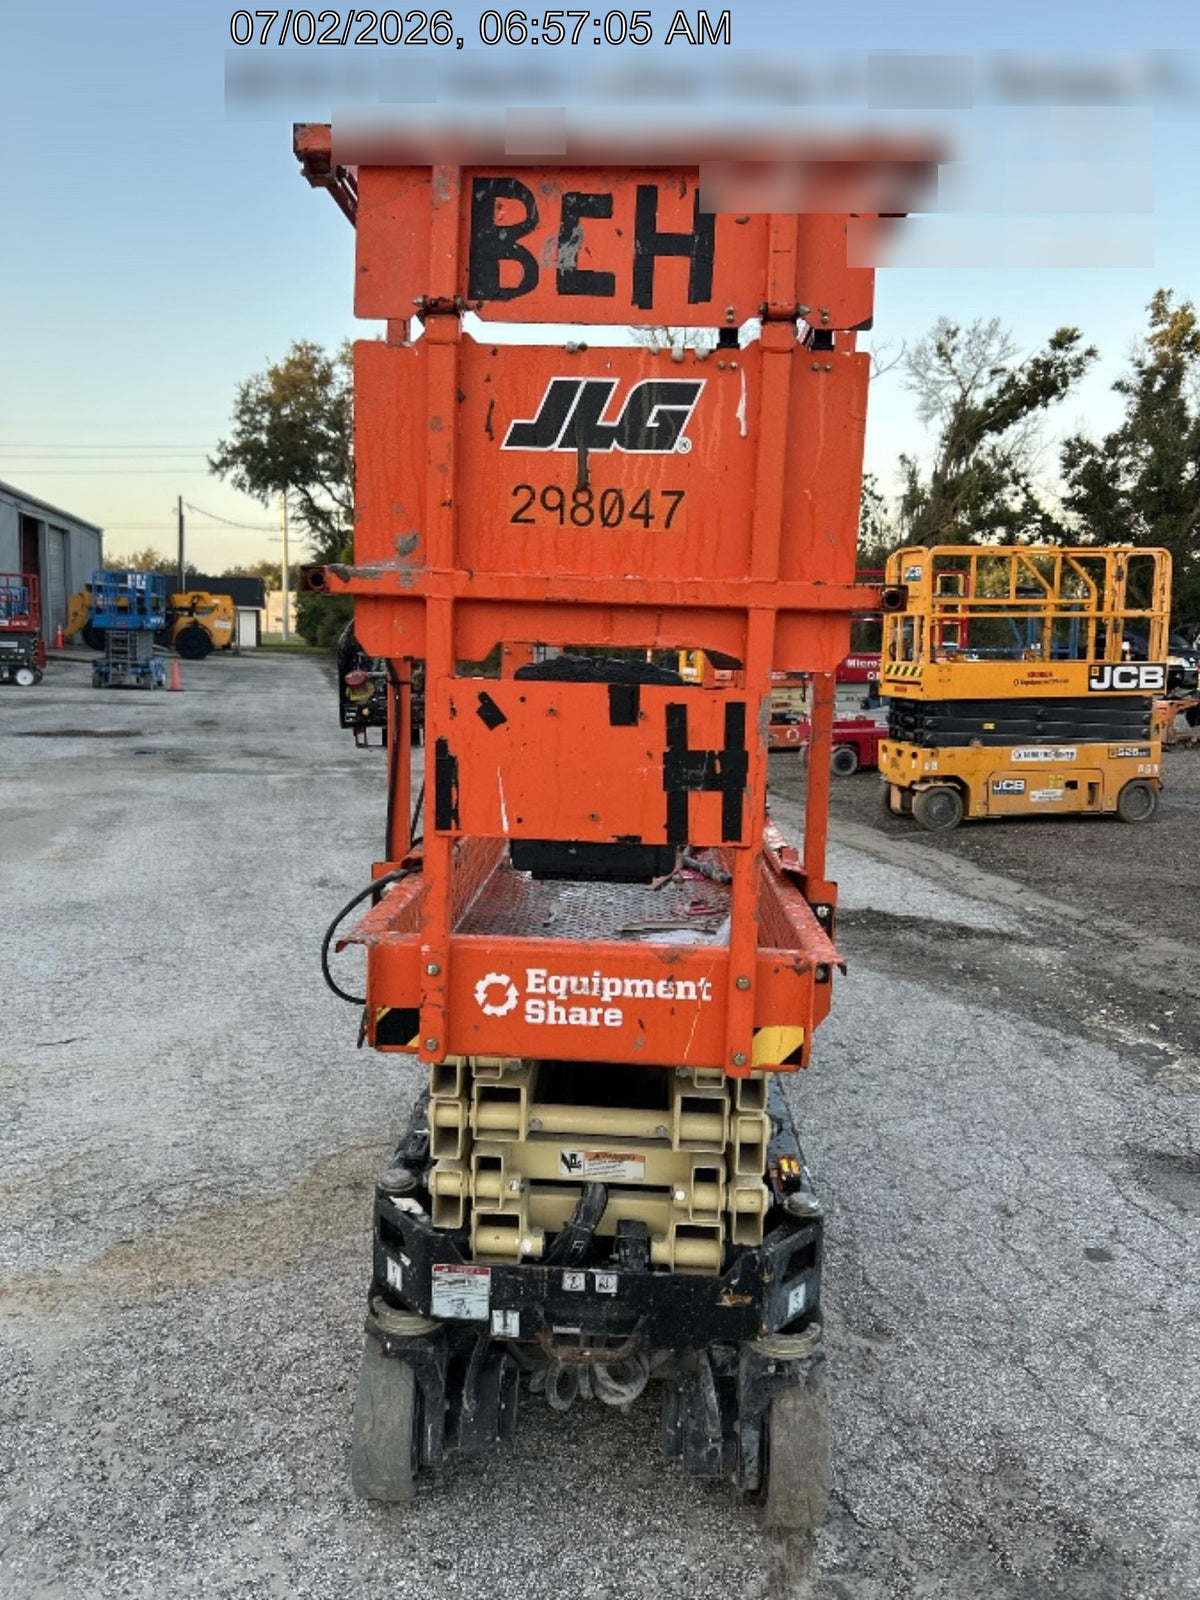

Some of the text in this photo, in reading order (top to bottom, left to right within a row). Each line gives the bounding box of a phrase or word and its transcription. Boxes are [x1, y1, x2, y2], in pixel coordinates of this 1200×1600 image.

[500, 376, 708, 454] JLG
[510, 483, 686, 530] 298047
[1090, 666, 1165, 690] JCB
[992, 779, 1026, 791] JCB
[526, 968, 712, 1002] Equipment
[525, 999, 623, 1027] Share
